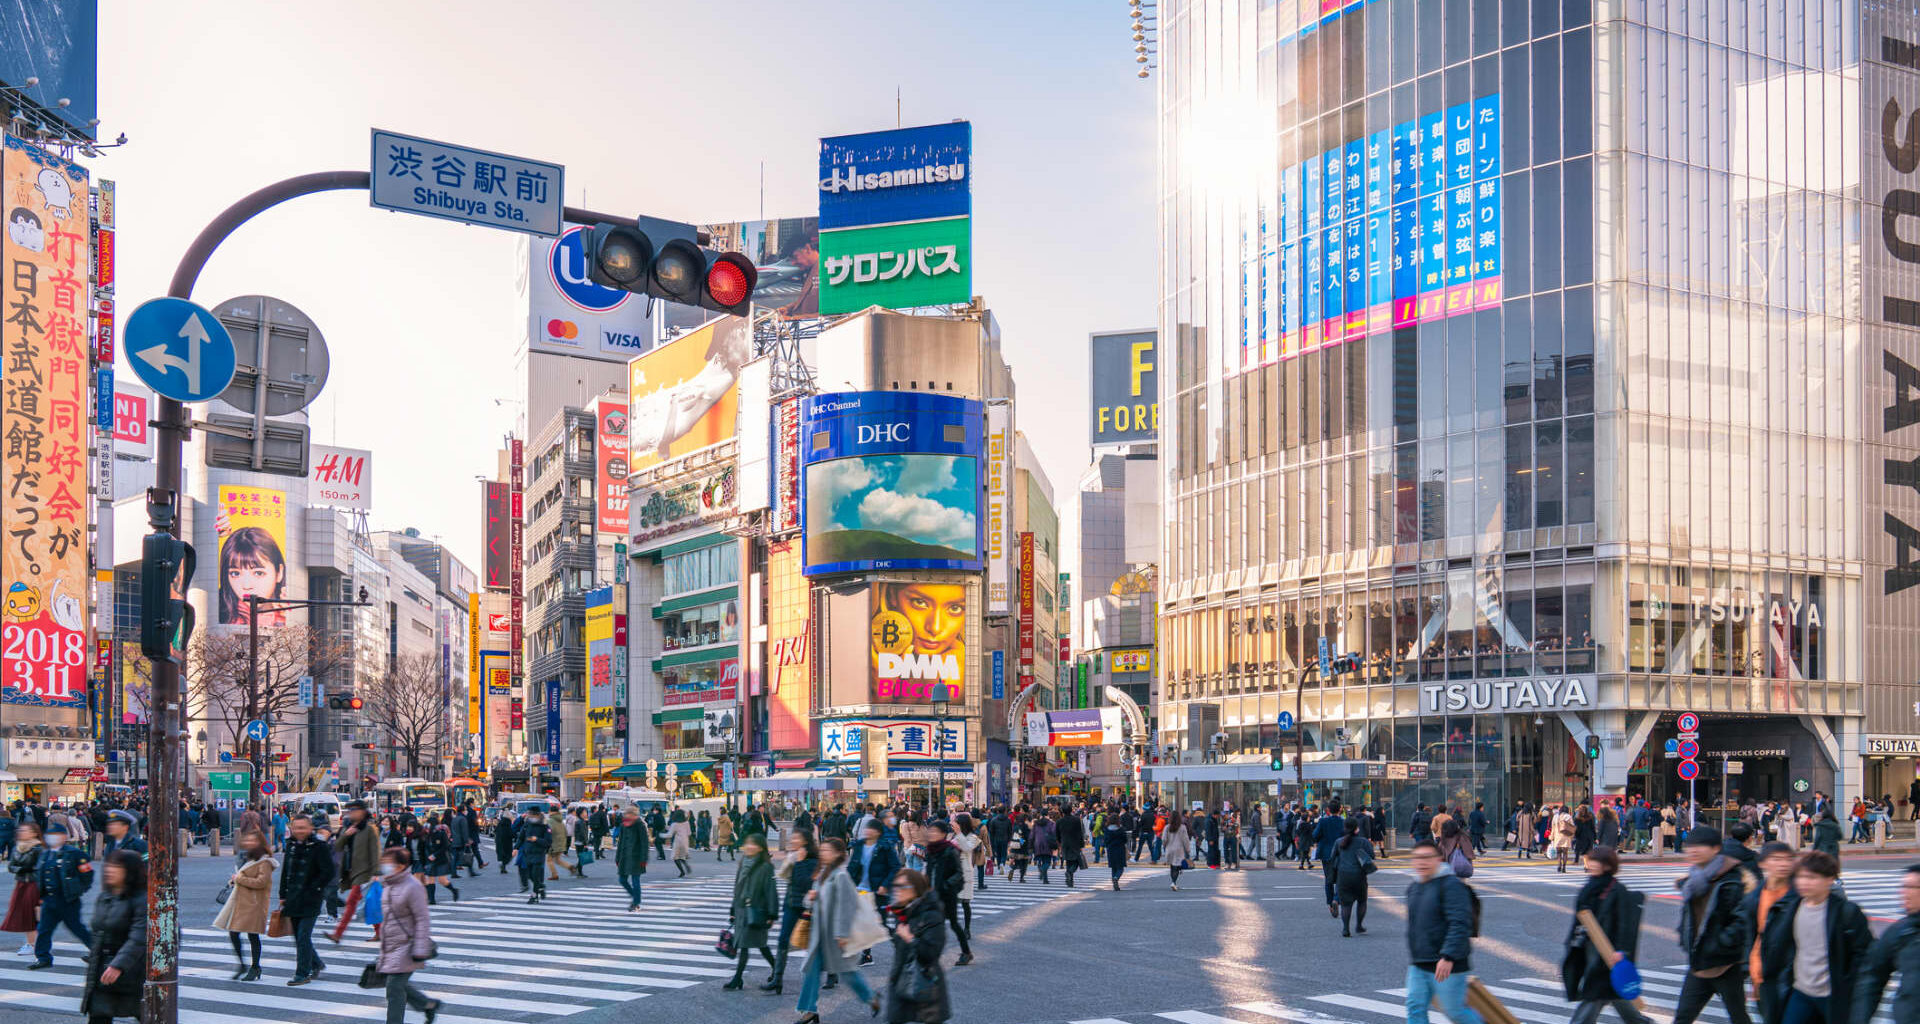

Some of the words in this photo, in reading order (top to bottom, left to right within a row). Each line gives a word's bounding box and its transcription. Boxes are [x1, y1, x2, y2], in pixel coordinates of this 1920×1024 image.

[388, 144, 549, 204] 渋谷駅前
[818, 163, 965, 194] Hisamitsu
[413, 186, 488, 216] Shibuya
[494, 200, 530, 223] Sta.
[824, 244, 961, 286] サロンパス
[101, 326, 112, 355] ガスト
[604, 331, 641, 349] VISA
[1131, 341, 1154, 397] F
[43, 220, 86, 562] 打首獄門同好会が
[810, 402, 827, 416] DHC
[827, 399, 862, 412] Channel
[6, 258, 45, 577] 日本武道館だって。
[857, 422, 911, 445] DHC
[101, 443, 111, 496] 渋谷駅前ビル
[314, 453, 365, 487] H&M
[990, 427, 1005, 498] Taisei
[990, 502, 1002, 560] neon
[875, 560, 892, 568] DHC
[1692, 594, 1823, 628] TSUTAYA
[3, 624, 85, 666] 2018
[13, 662, 72, 699] 3.11
[721, 663, 738, 683] JTB
[878, 652, 961, 681] DMM
[877, 678, 960, 698] Bitcon
[1424, 679, 1589, 712] TSUTAYA
[826, 726, 959, 753] 大盛書店
[1753, 749, 1786, 757] COFFEE
[1868, 739, 1919, 752] TSUTAYA
